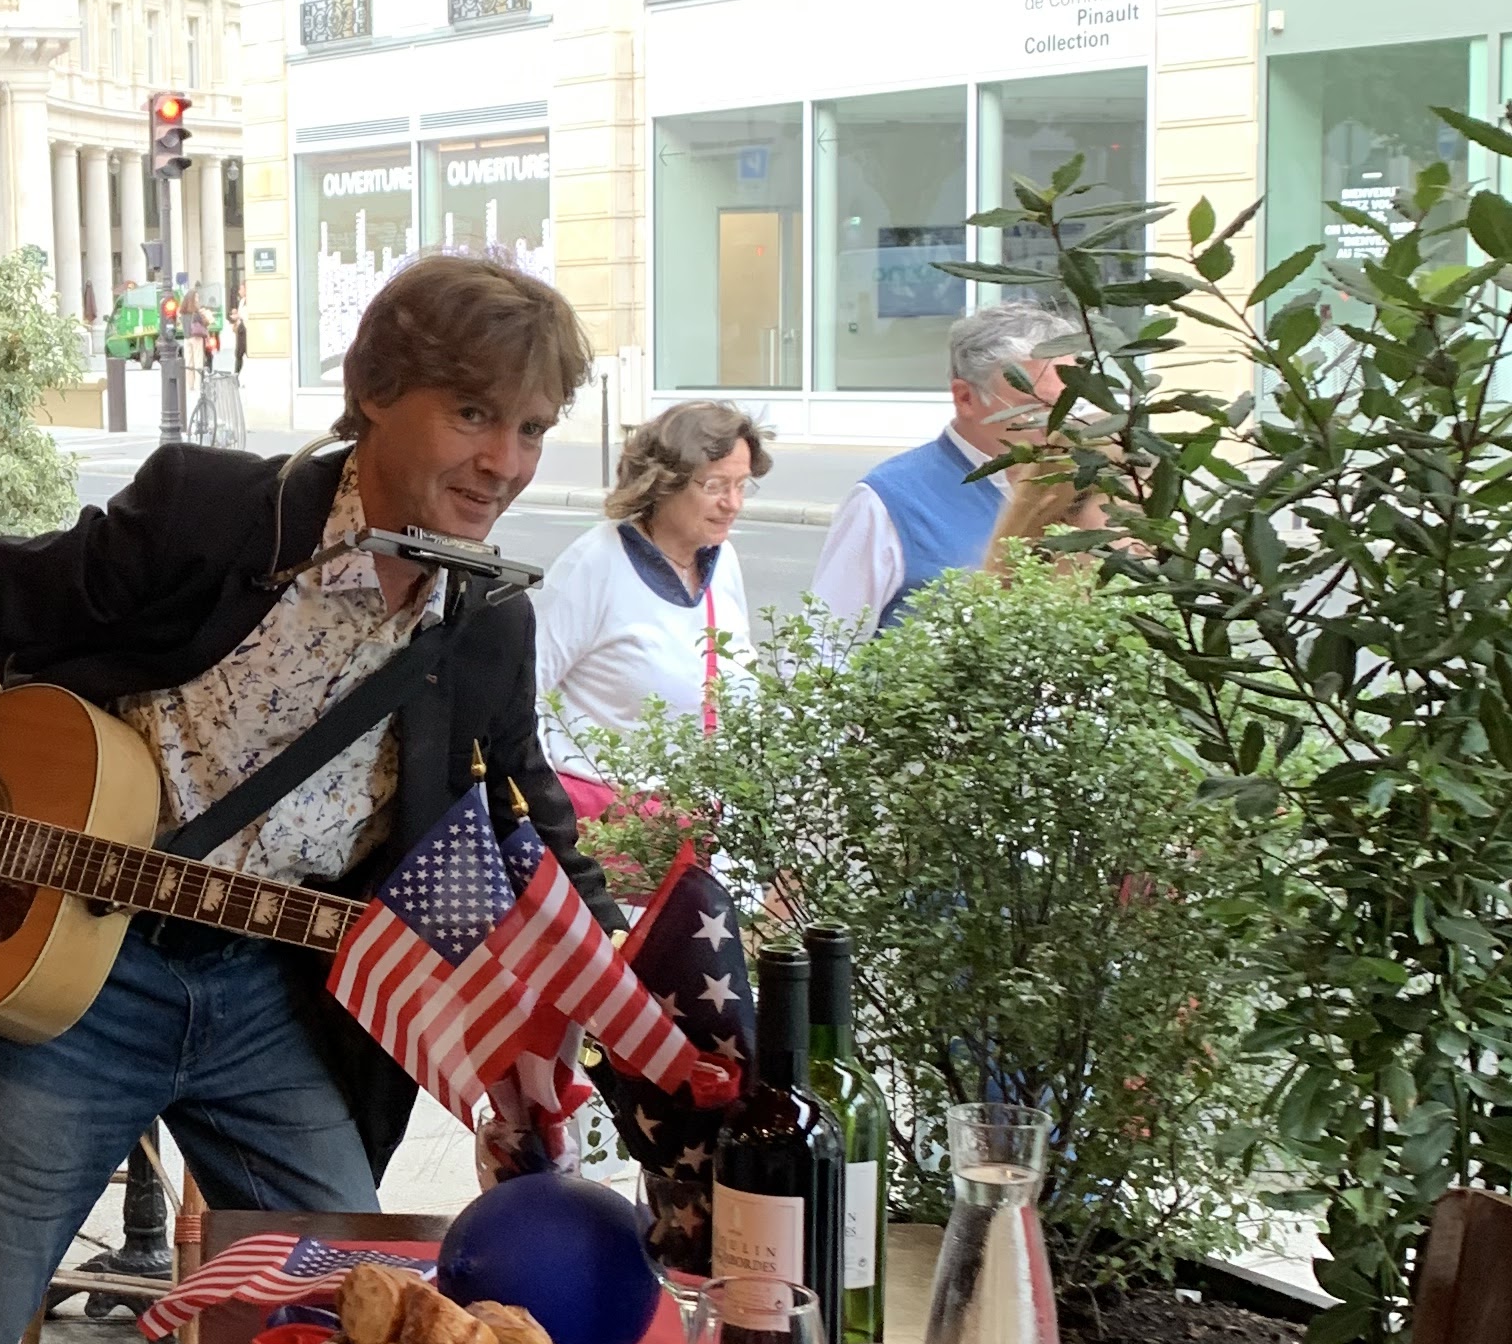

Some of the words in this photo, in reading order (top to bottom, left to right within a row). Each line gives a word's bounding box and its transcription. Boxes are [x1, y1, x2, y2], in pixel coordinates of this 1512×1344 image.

[1077, 2, 1140, 27] Pinault
[1024, 30, 1110, 55] Collection
[323, 166, 413, 197] OUVERTURE
[447, 153, 549, 186] OUVERTURE
